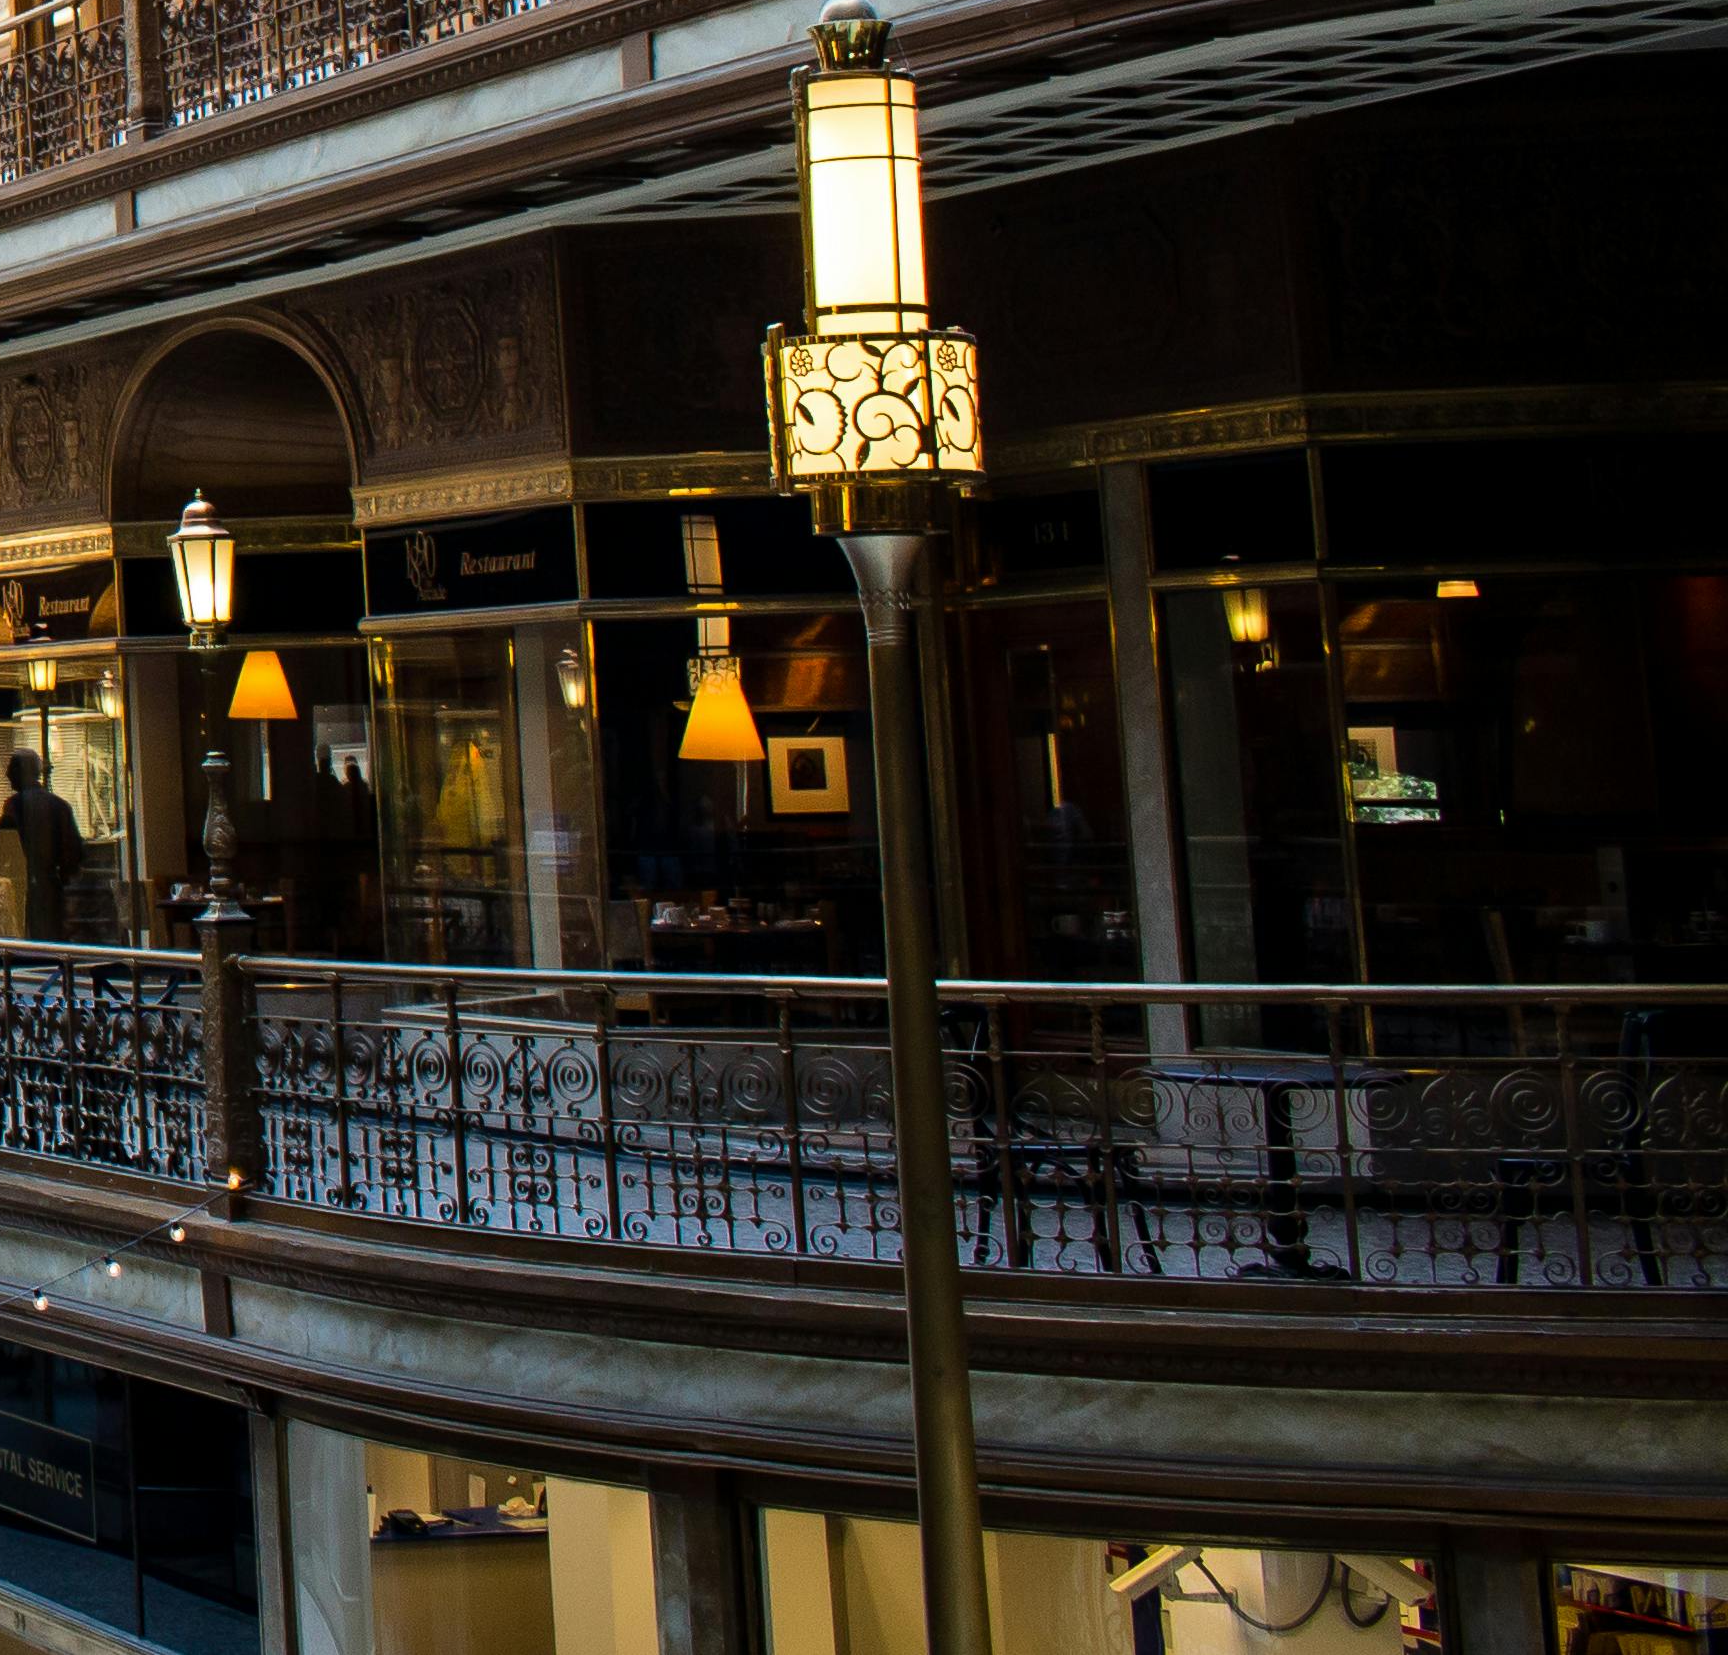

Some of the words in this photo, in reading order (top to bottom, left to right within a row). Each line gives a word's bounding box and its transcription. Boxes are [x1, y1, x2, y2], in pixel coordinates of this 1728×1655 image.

[459, 548, 538, 577] Restaurant
[38, 595, 91, 617] Restaurant
[28, 1458, 83, 1498] SERVICE
